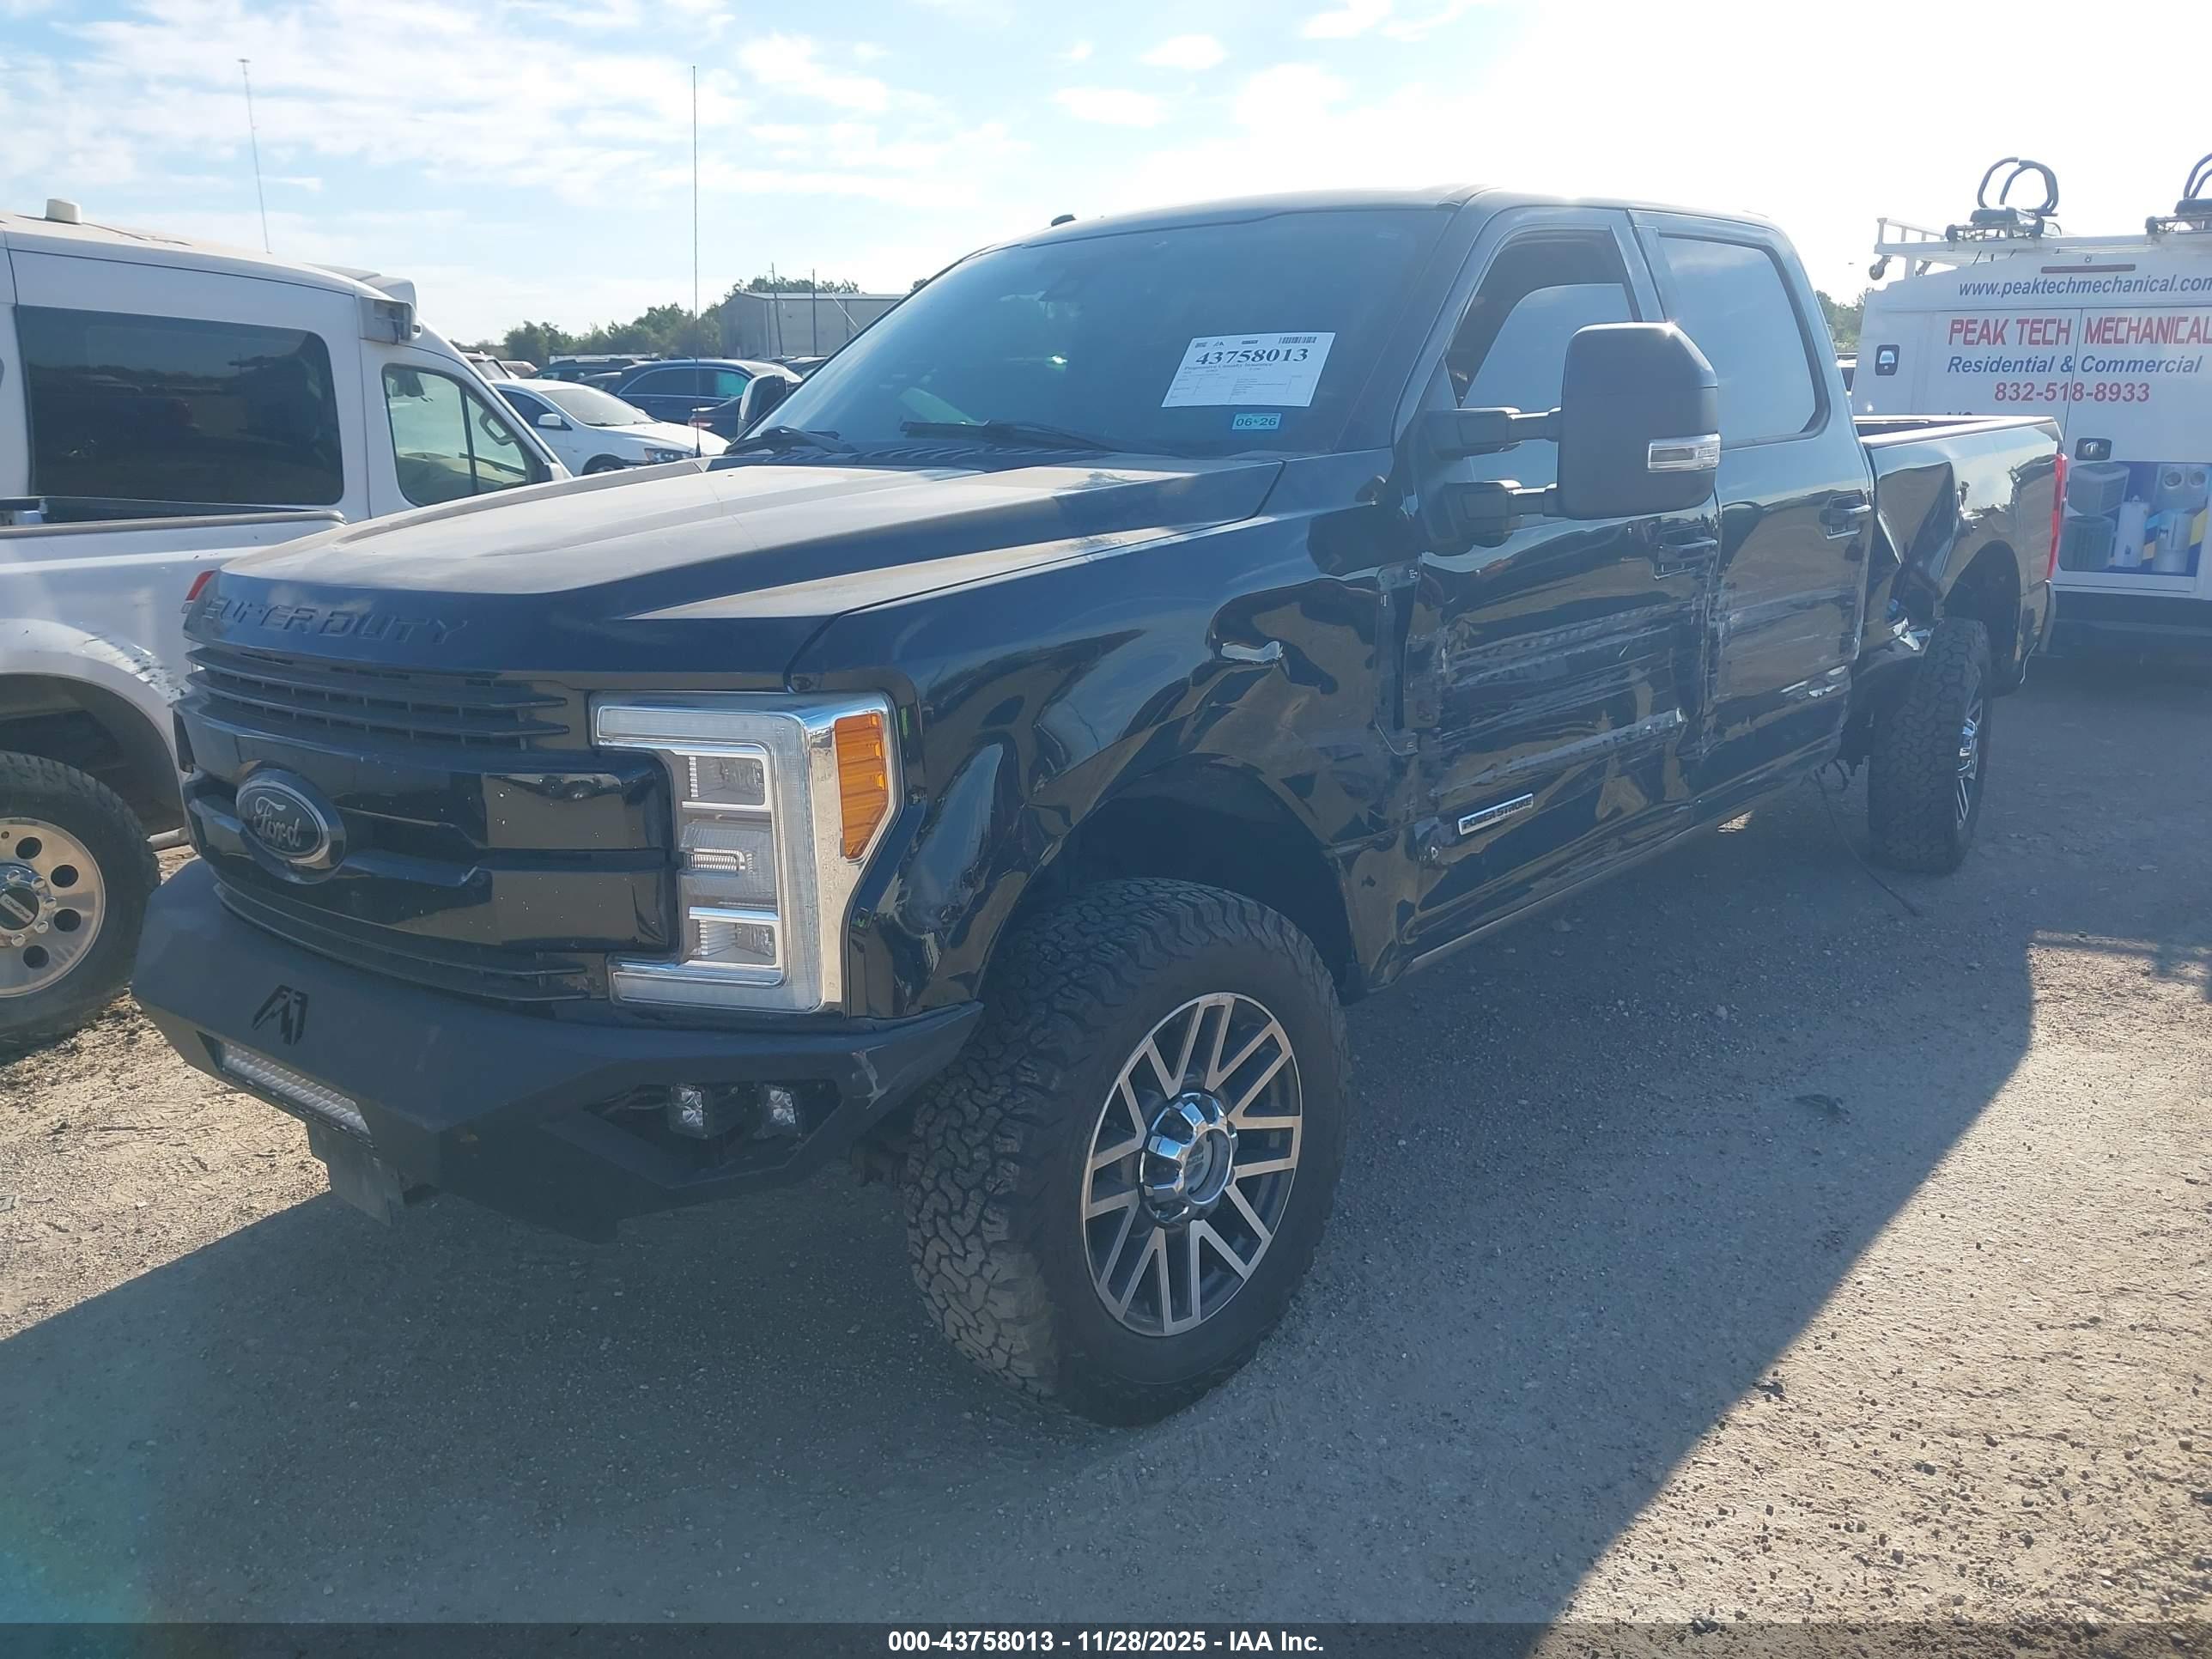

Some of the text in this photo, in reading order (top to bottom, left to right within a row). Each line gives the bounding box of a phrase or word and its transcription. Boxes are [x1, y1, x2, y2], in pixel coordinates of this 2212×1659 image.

[1948, 316, 2212, 345] PEAK TECH MECHANICAL
[1194, 348, 1310, 365] 43758013
[1947, 355, 2203, 374] Residential & Commercial
[1994, 381, 2150, 403] 832-518-8933
[319, 609, 469, 644] DUTY
[254, 795, 301, 848] Ford
